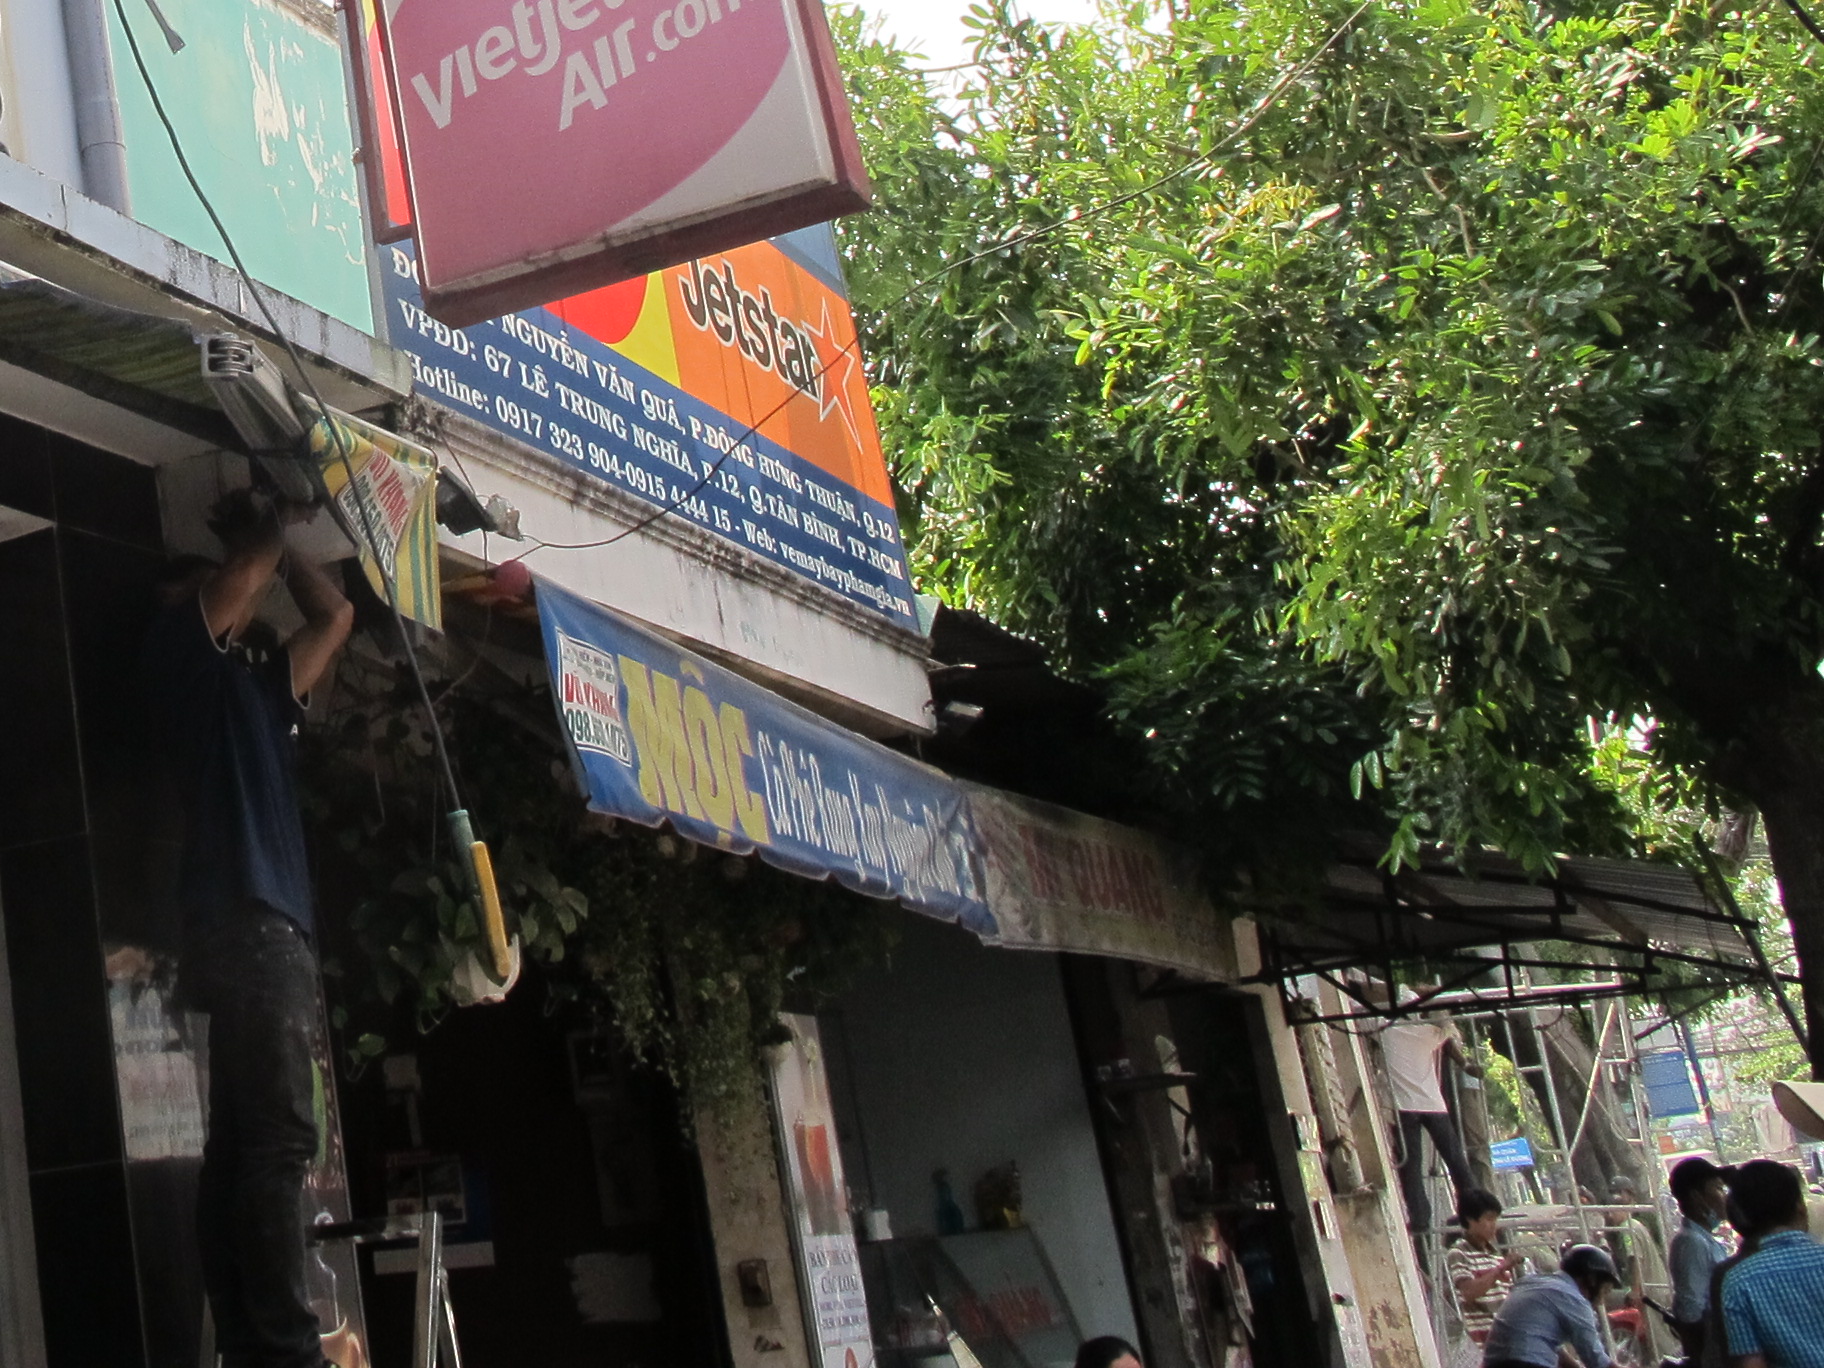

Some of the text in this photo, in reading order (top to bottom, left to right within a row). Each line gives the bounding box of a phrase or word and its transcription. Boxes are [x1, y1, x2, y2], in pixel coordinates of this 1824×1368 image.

[678, 258, 822, 404] Jetstar
[404, 349, 491, 415] Hotline:
[495, 395, 543, 440] 0917
[548, 421, 584, 461] 323
[588, 441, 666, 502] 904-0915
[712, 505, 731, 533] 15
[742, 518, 778, 554] Web:
[484, 344, 512, 379] 67
[517, 361, 549, 399] LÊ
[555, 381, 627, 442] TRUNG
[749, 485, 799, 529] Q.TÂN
[847, 535, 904, 581] TP.HCM
[592, 360, 636, 405] VĂN
[863, 511, 896, 544] Q.12
